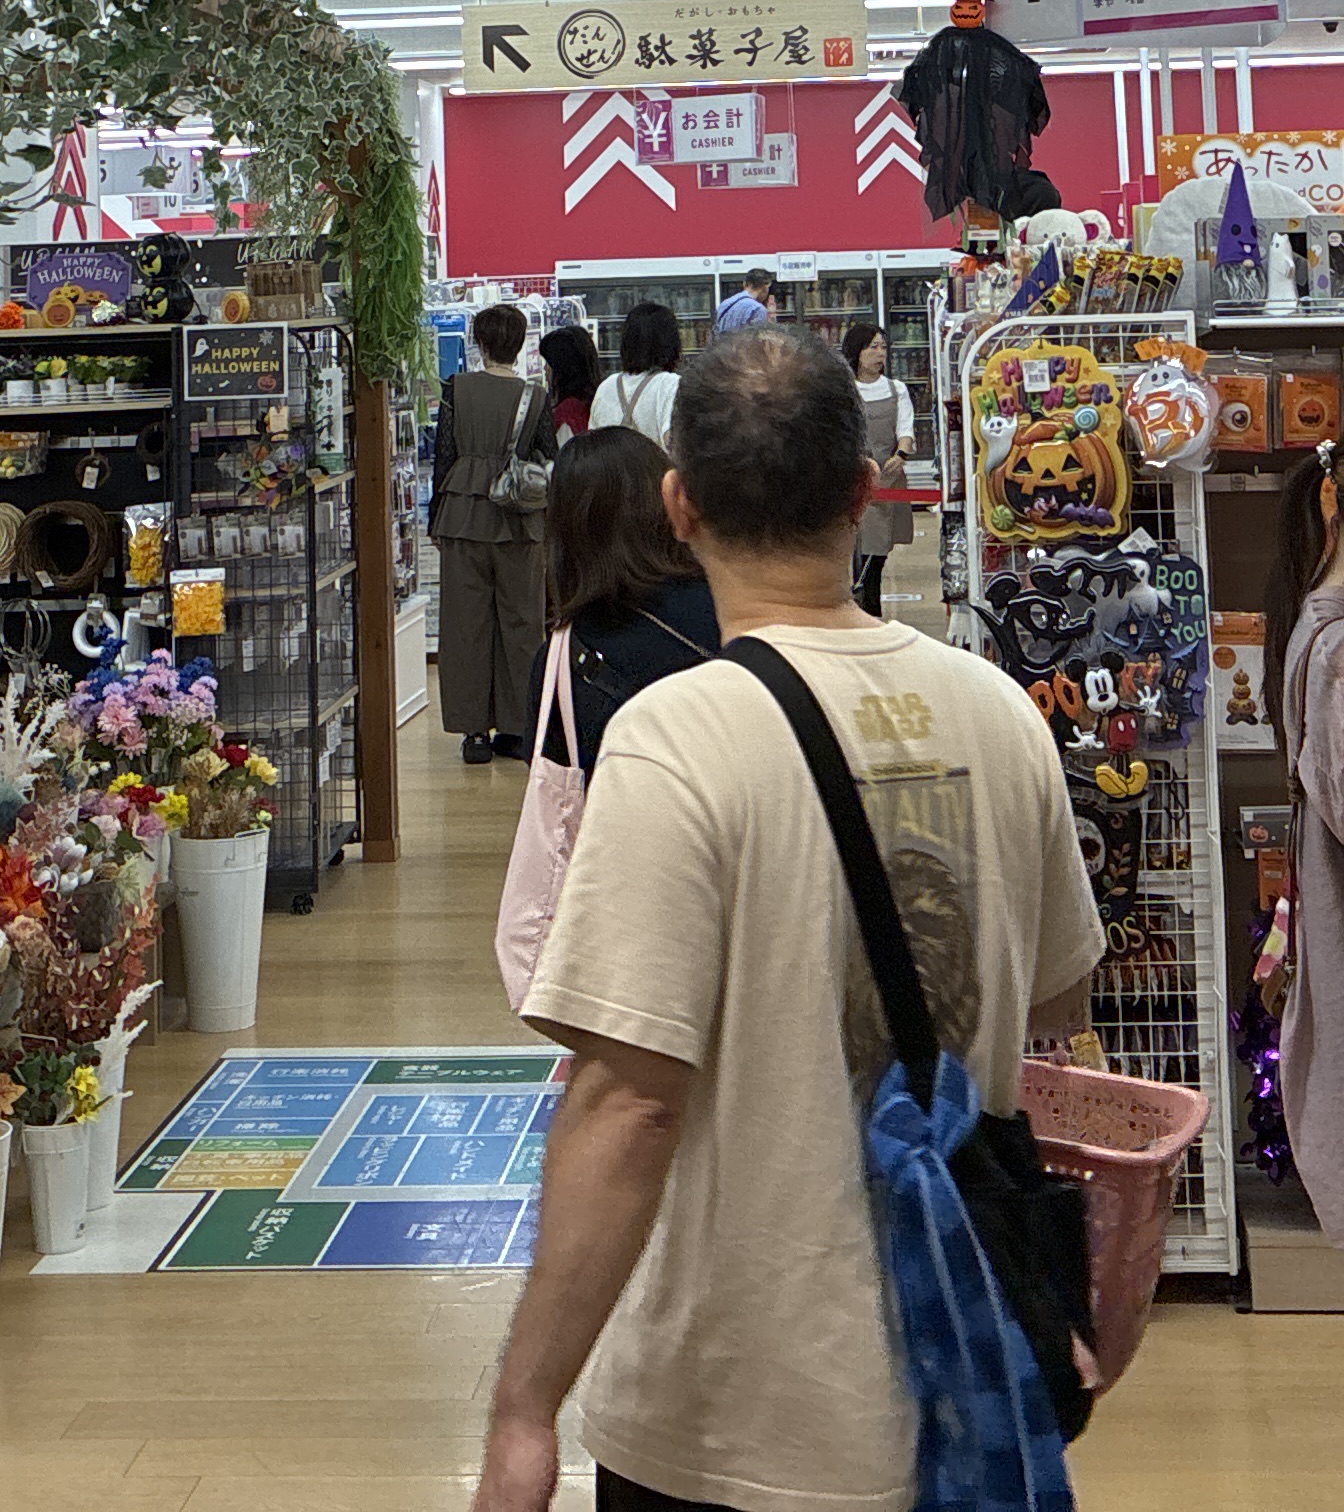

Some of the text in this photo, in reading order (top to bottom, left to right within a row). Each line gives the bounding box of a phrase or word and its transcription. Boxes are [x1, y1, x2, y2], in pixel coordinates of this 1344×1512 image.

[674, 5, 777, 18] だがし・おもちゃ
[634, 25, 816, 69] 駄菓子屋
[681, 107, 744, 131] お会計
[690, 136, 735, 149] CASHIER
[742, 164, 776, 176] CASHIER
[1199, 145, 1327, 177] あったか
[63, 257, 103, 267] HAPPY
[37, 266, 123, 285] HALLOWEEN
[211, 347, 261, 360] HAPPY
[191, 360, 280, 376] HALLOWEEN
[1000, 356, 1080, 386] Hpy
[1156, 565, 1198, 590] BOO
[1175, 594, 1204, 616] TO
[1170, 619, 1206, 644] YOU
[1107, 916, 1145, 954] OS
